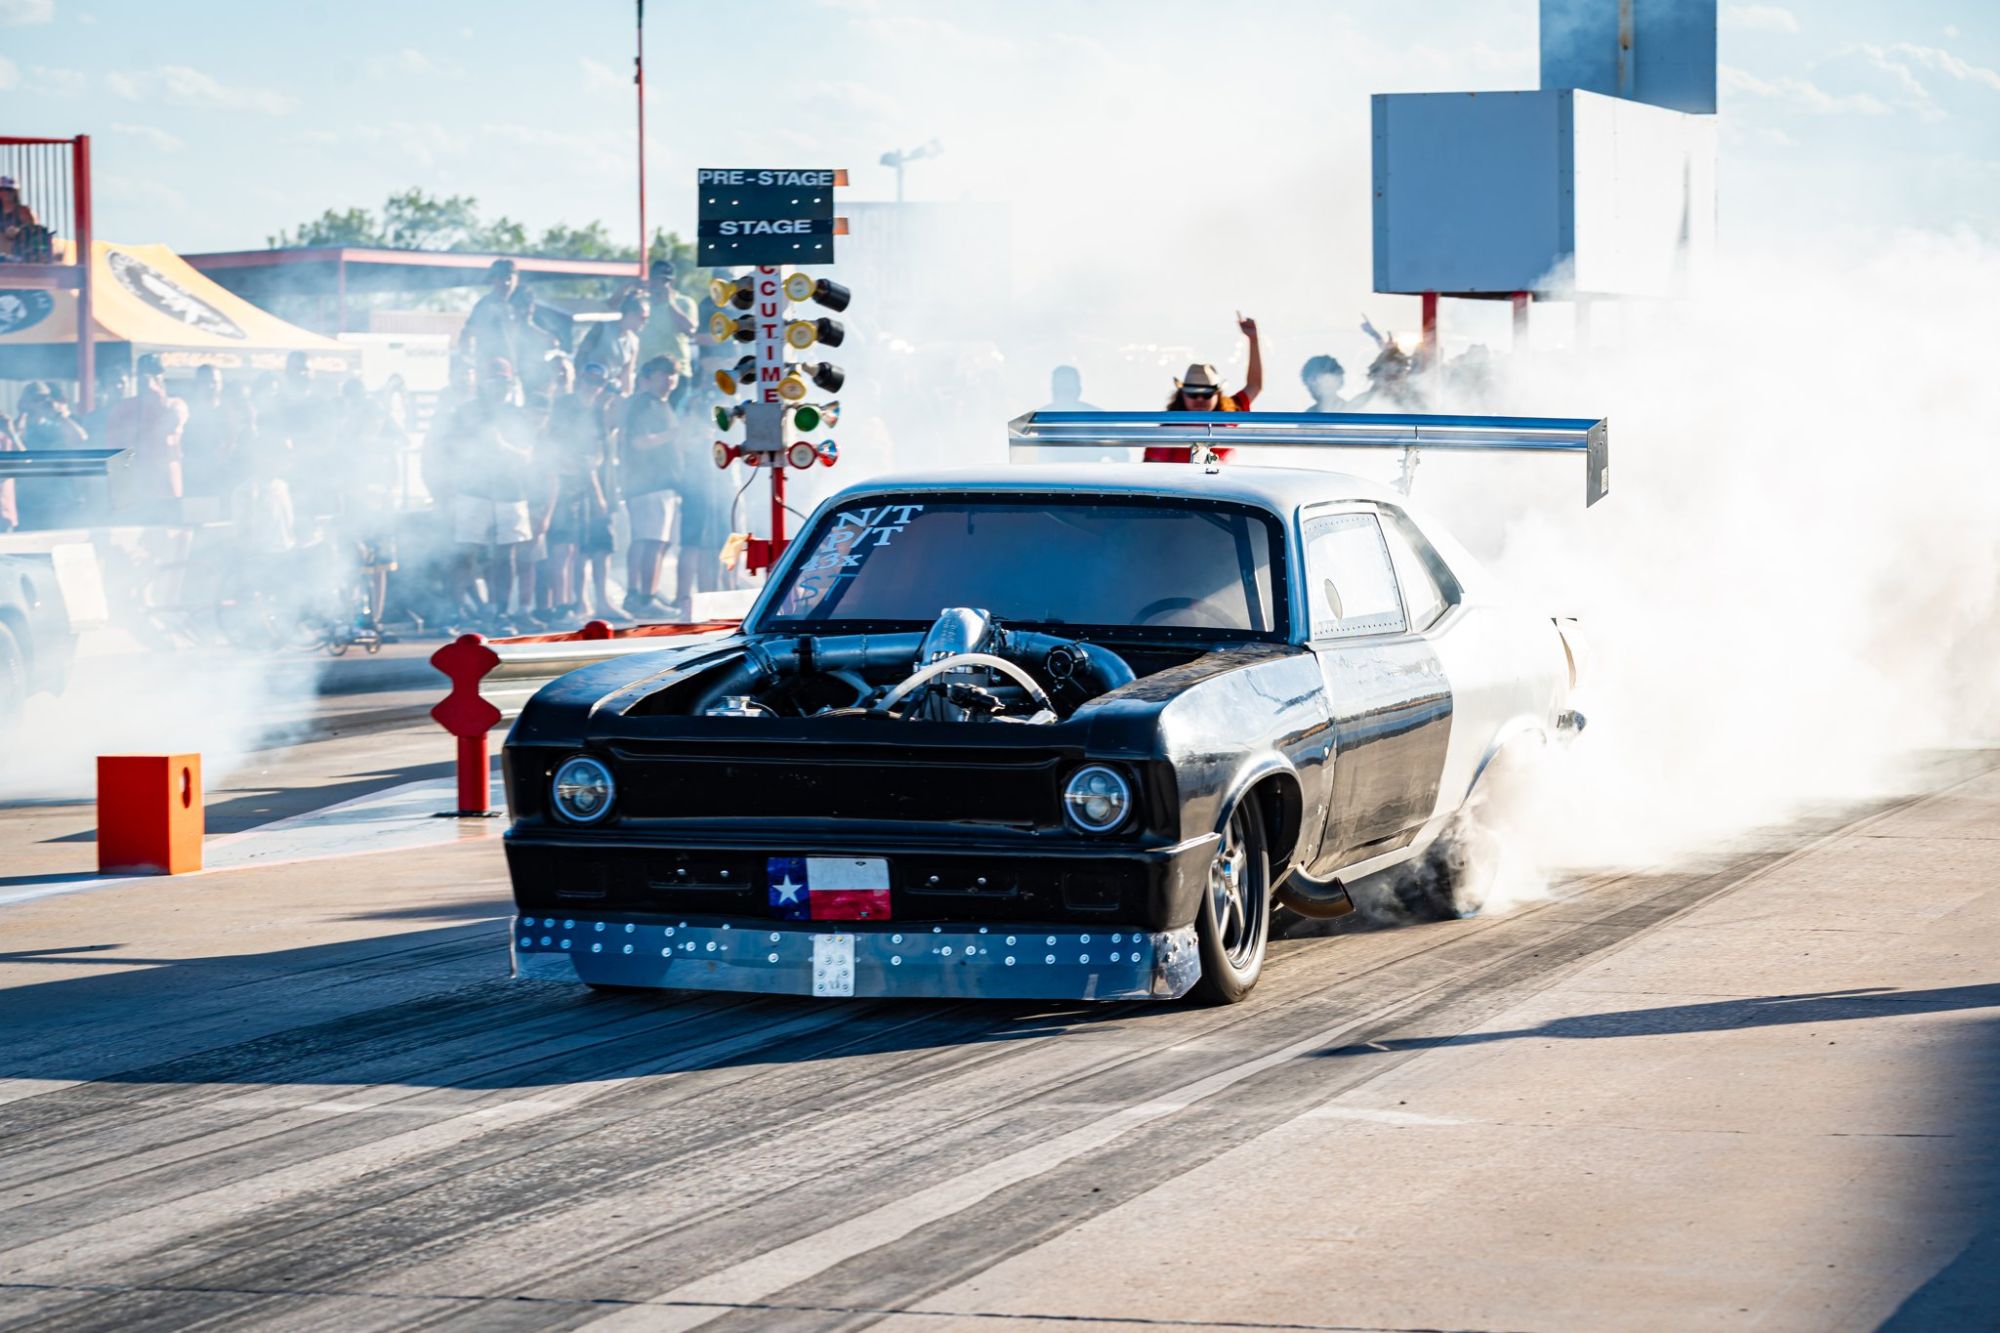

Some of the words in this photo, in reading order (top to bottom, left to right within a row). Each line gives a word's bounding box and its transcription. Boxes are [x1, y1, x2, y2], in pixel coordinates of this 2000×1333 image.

[699, 170, 833, 186] PRE-STAGE
[719, 219, 813, 236] STAGE
[832, 504, 924, 531] N/T
[821, 525, 904, 553] P/T
